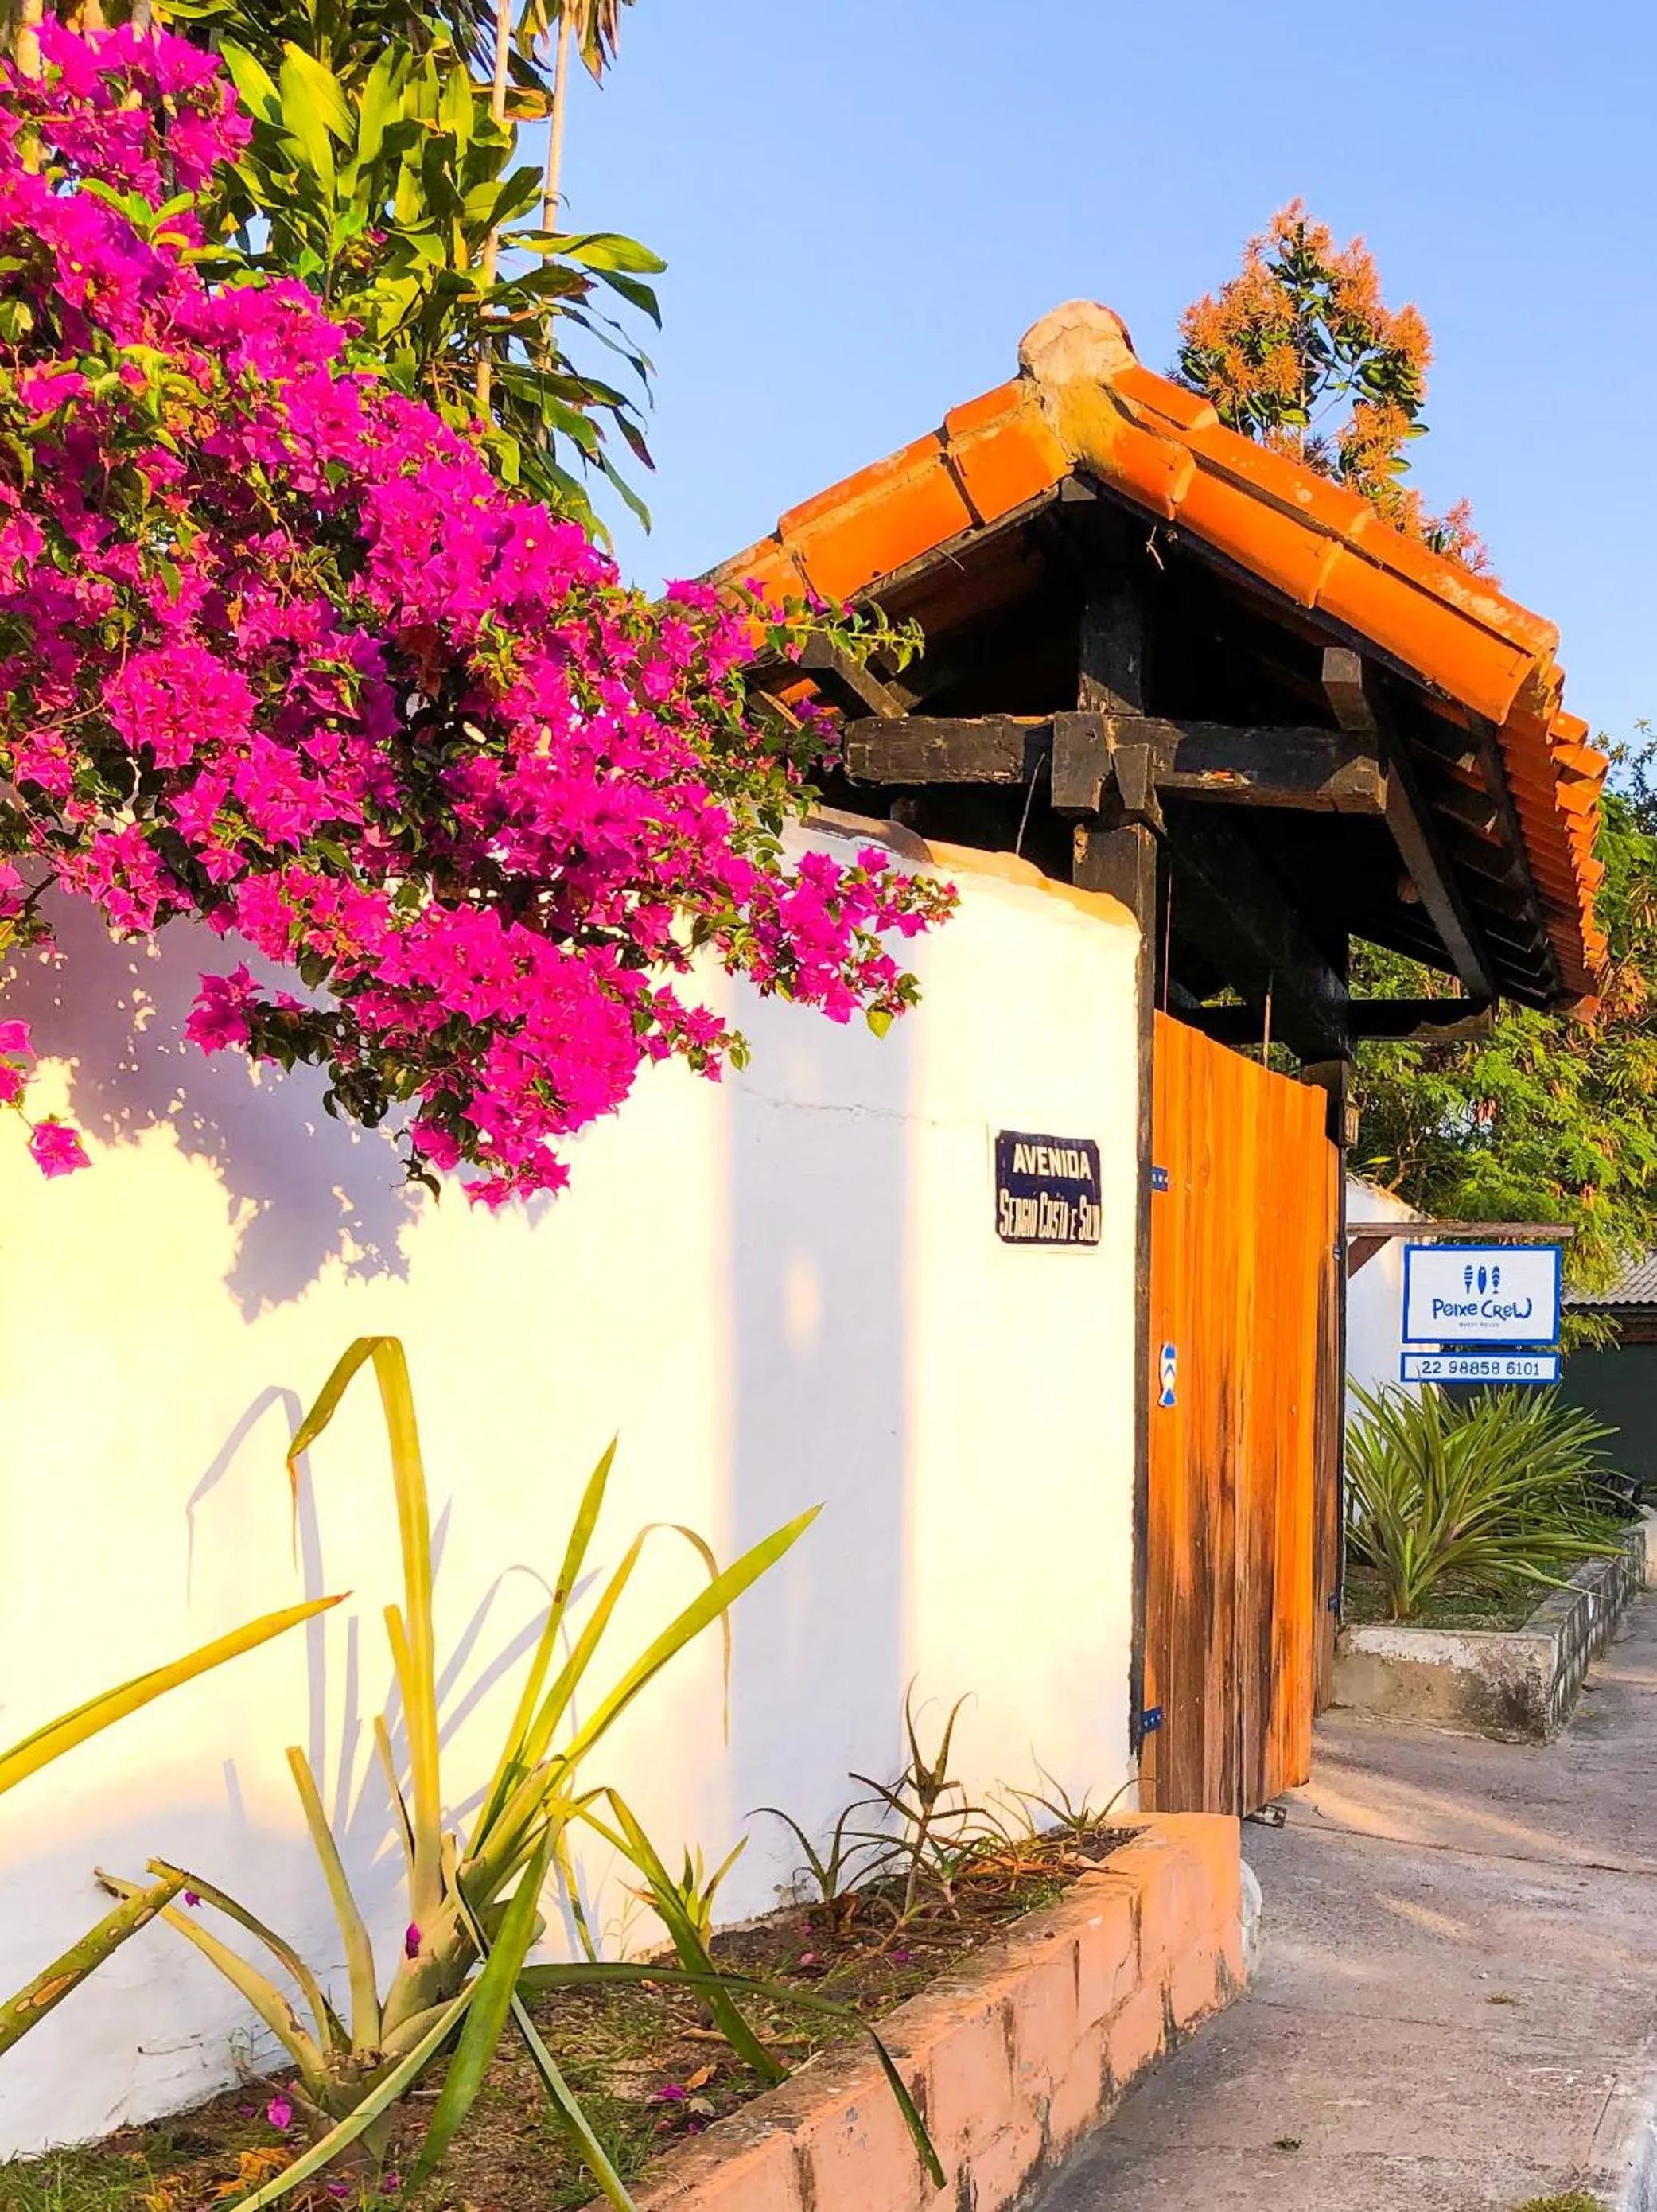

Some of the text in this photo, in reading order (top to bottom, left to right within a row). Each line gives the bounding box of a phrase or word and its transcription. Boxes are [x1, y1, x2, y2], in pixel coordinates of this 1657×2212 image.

[1012, 1143, 1091, 1180] AVENIDA
[1038, 1191, 1069, 1240] COSTA
[1422, 1361, 1540, 1376] 22 98858 6101
